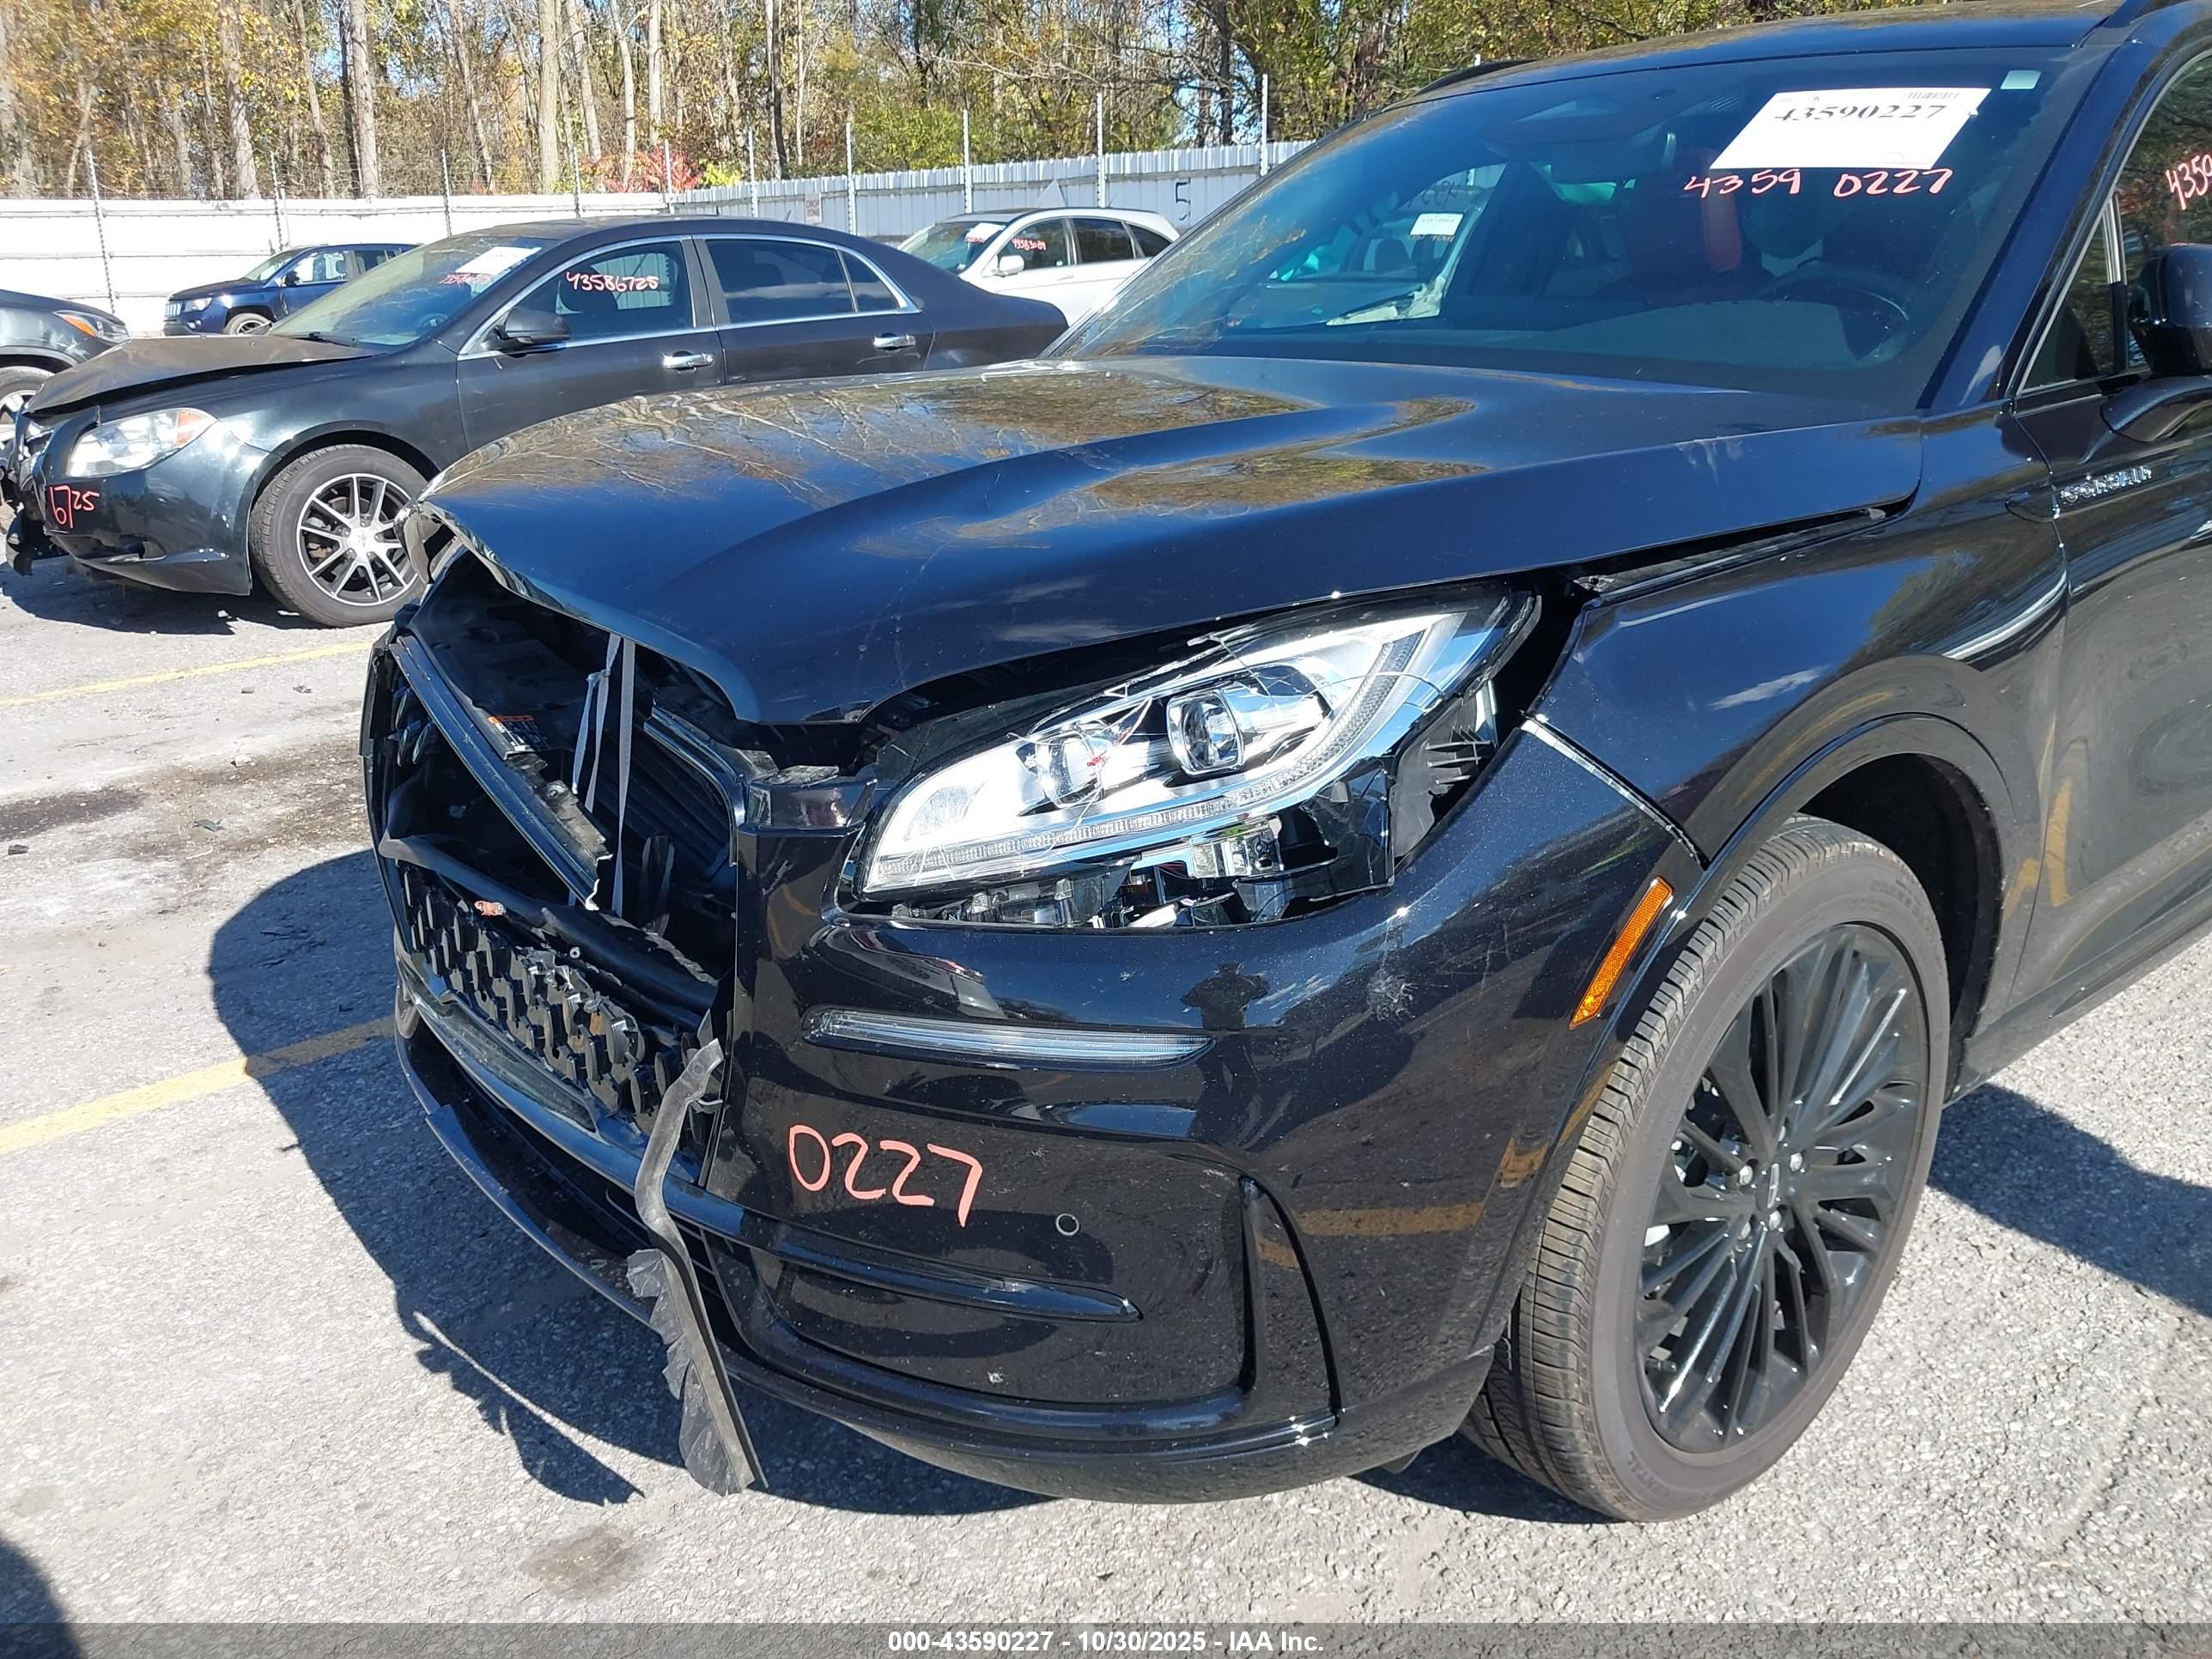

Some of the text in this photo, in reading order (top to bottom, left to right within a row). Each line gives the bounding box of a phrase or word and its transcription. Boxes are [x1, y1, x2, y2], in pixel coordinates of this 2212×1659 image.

[1684, 168, 1954, 198] 4359 0227
[566, 271, 659, 292] 43586725
[48, 484, 100, 529] 6725
[787, 1124, 983, 1228] 0227
